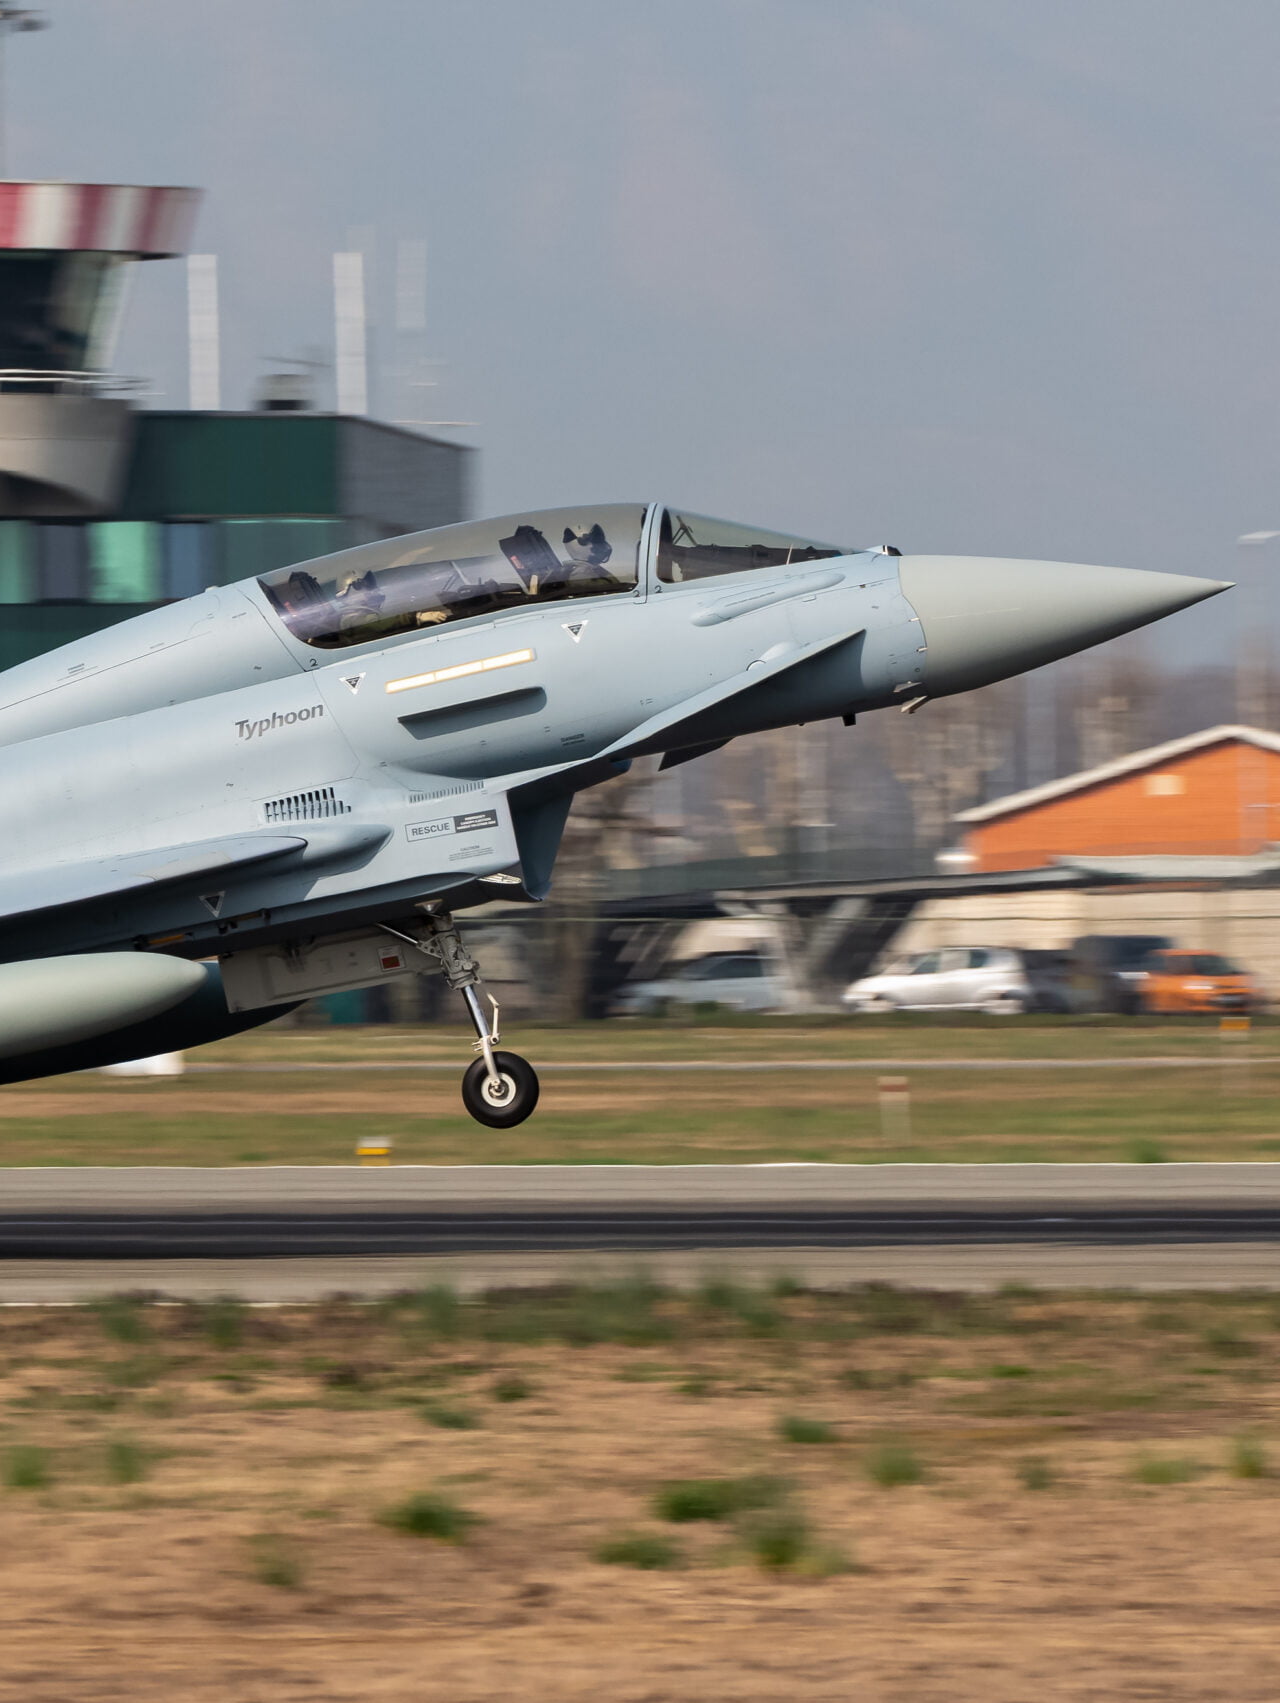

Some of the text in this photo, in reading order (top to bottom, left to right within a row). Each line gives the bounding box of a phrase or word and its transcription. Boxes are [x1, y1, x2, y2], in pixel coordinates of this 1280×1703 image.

[633, 589, 640, 597] 2
[654, 585, 663, 593] 2
[310, 658, 318, 668] 2
[235, 704, 323, 741] Typhoon
[411, 822, 450, 836] RESCUE
